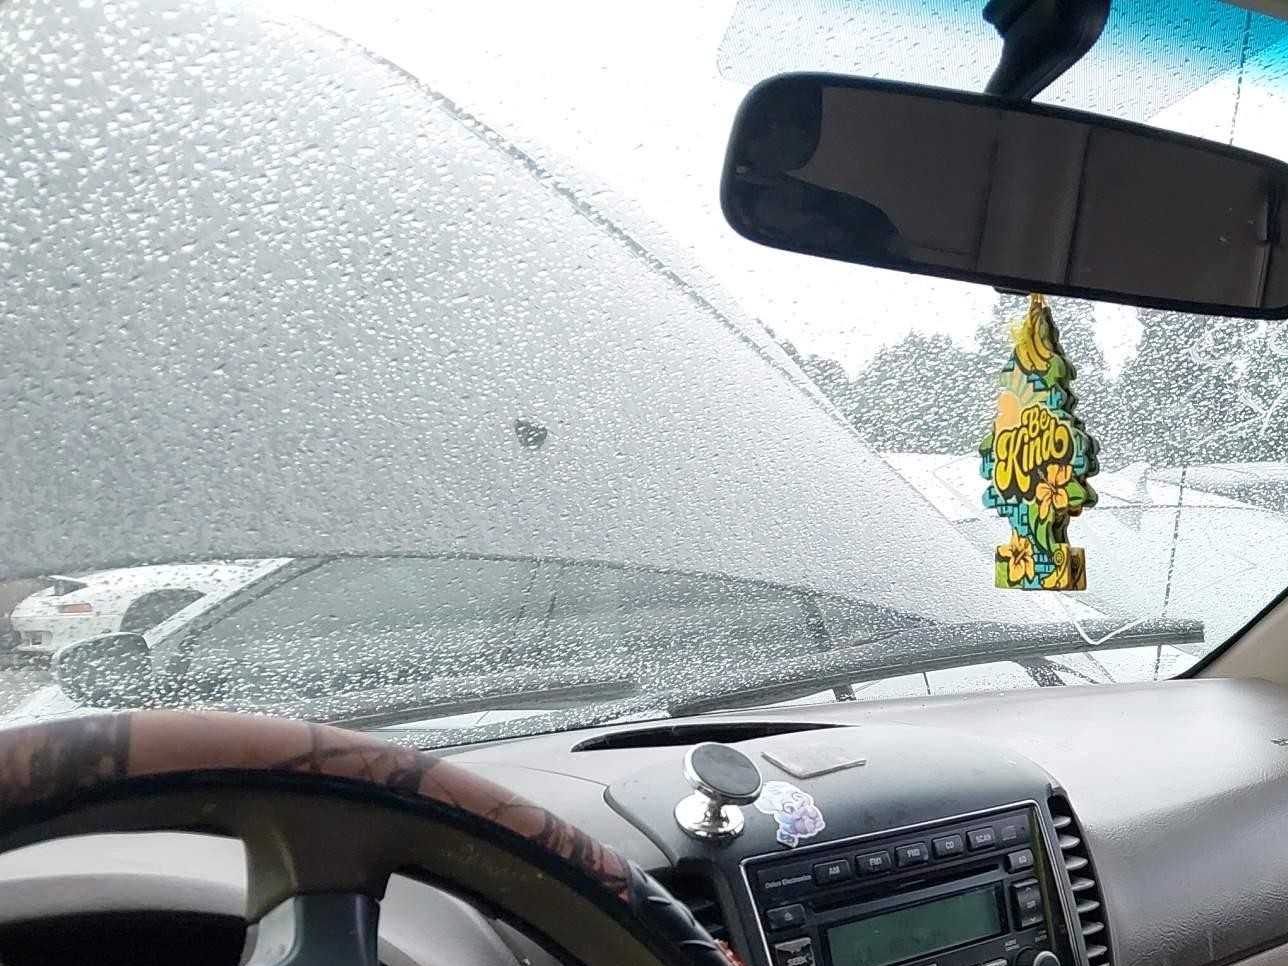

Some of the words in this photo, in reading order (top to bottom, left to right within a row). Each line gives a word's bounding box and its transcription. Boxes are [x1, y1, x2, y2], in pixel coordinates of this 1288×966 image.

[1021, 404, 1049, 438] Be
[995, 418, 1072, 493] Kind
[975, 834, 992, 843] SCAN
[945, 840, 955, 850] CD
[828, 865, 841, 876] AM
